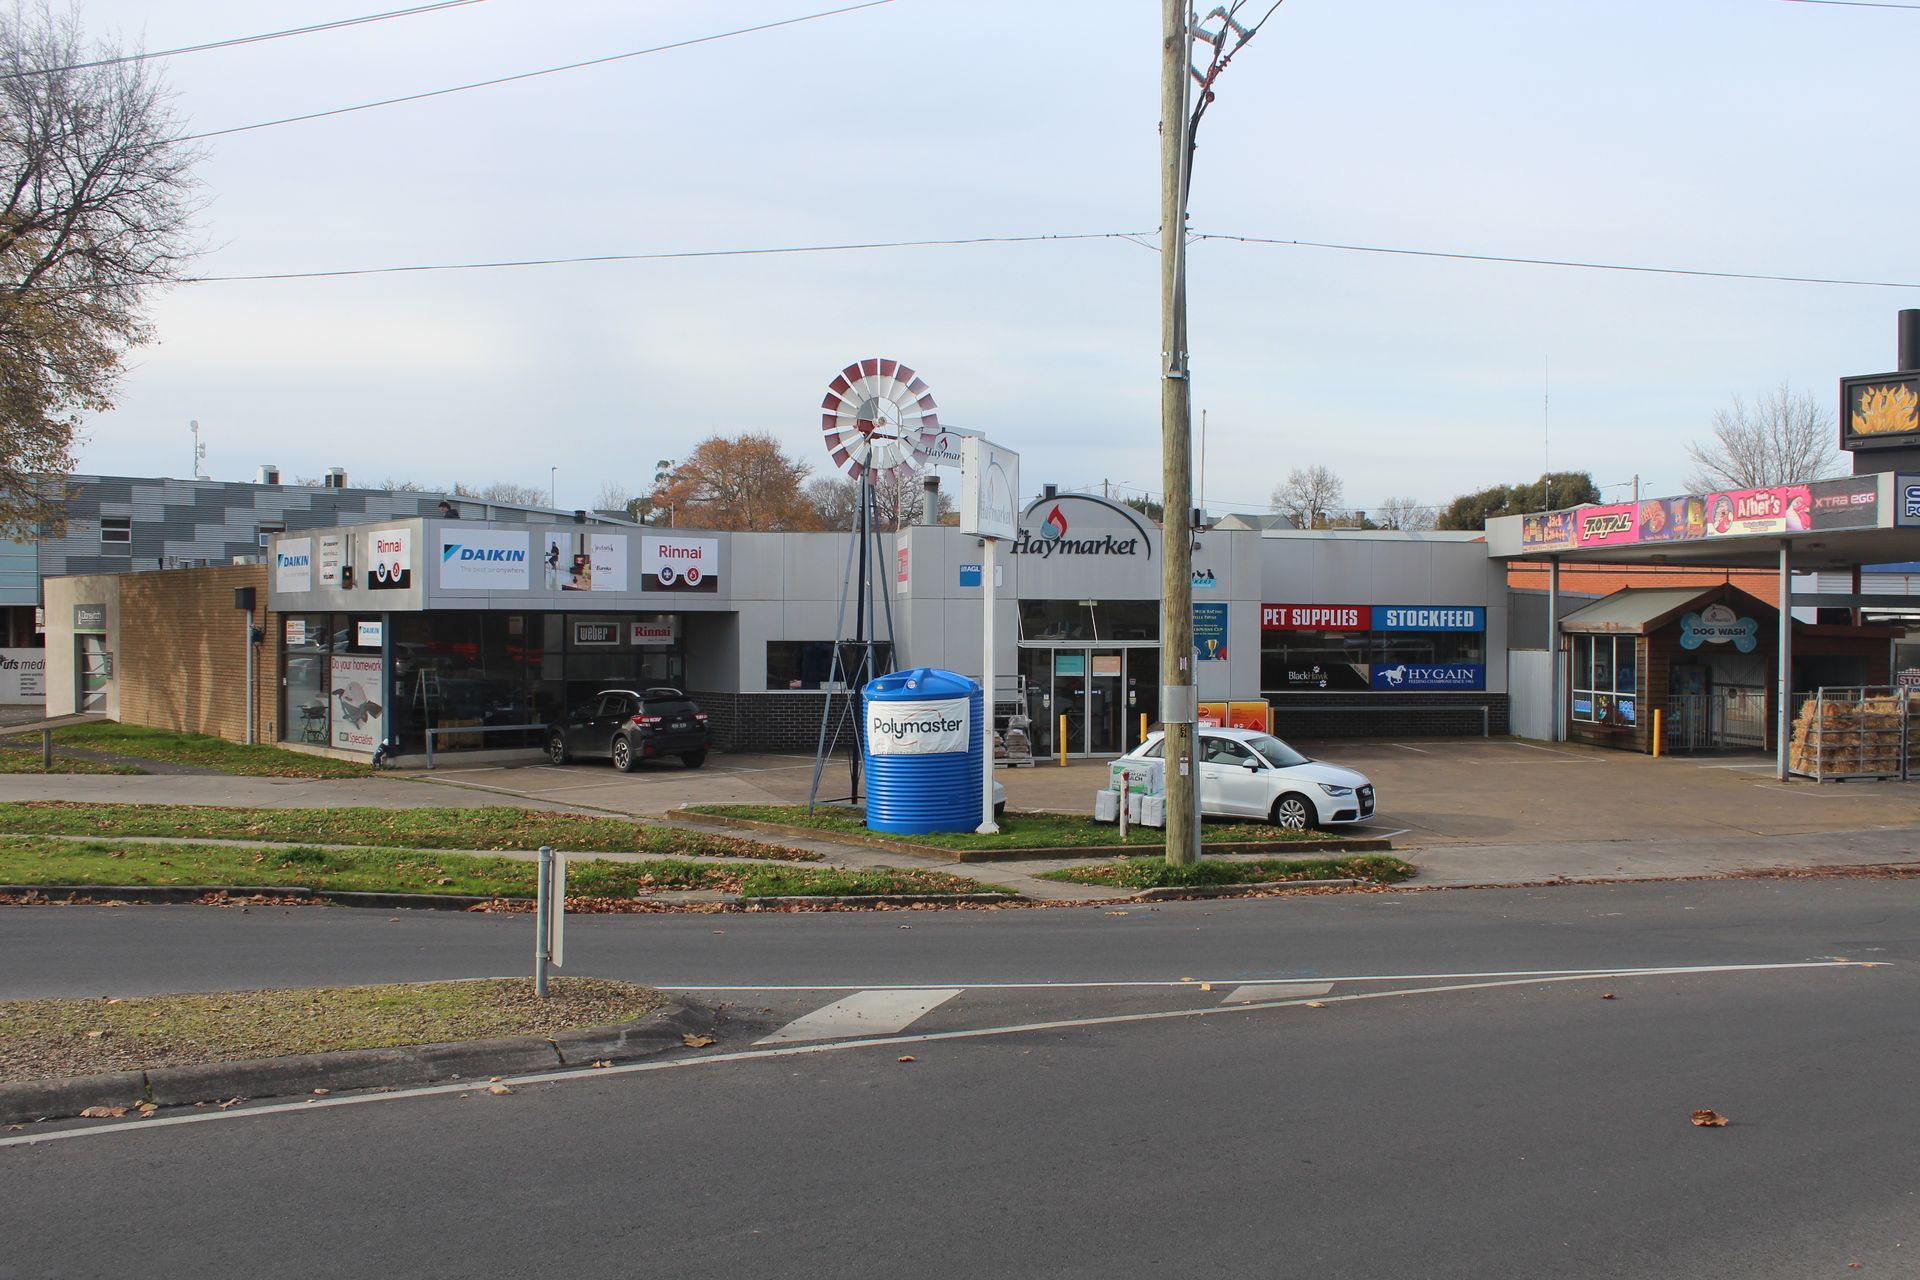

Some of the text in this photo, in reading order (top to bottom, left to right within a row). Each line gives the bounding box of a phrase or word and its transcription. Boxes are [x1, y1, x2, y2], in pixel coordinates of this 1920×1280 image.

[1737, 495, 1781, 518] Alber's
[1018, 527, 1030, 536] he
[377, 538, 402, 554] Rinnai
[659, 544, 702, 559] Rinnai
[1010, 535, 1138, 559] Haymarket
[283, 555, 309, 568] DAIKIN
[460, 548, 525, 562] DAIKIN
[1263, 608, 1358, 626] PET SUPPLIES
[1386, 609, 1474, 627] STOCKFEED
[362, 626, 380, 635] DAIKIN
[580, 626, 608, 641] weber
[635, 626, 672, 637] Rinnai
[1692, 628, 1746, 636] DOG WASH
[3, 659, 19, 670] ufs
[331, 657, 382, 673] Do your homework
[1408, 668, 1474, 680] HYGAIN
[873, 717, 963, 739] Polymaster
[348, 731, 374, 746] Specialist
